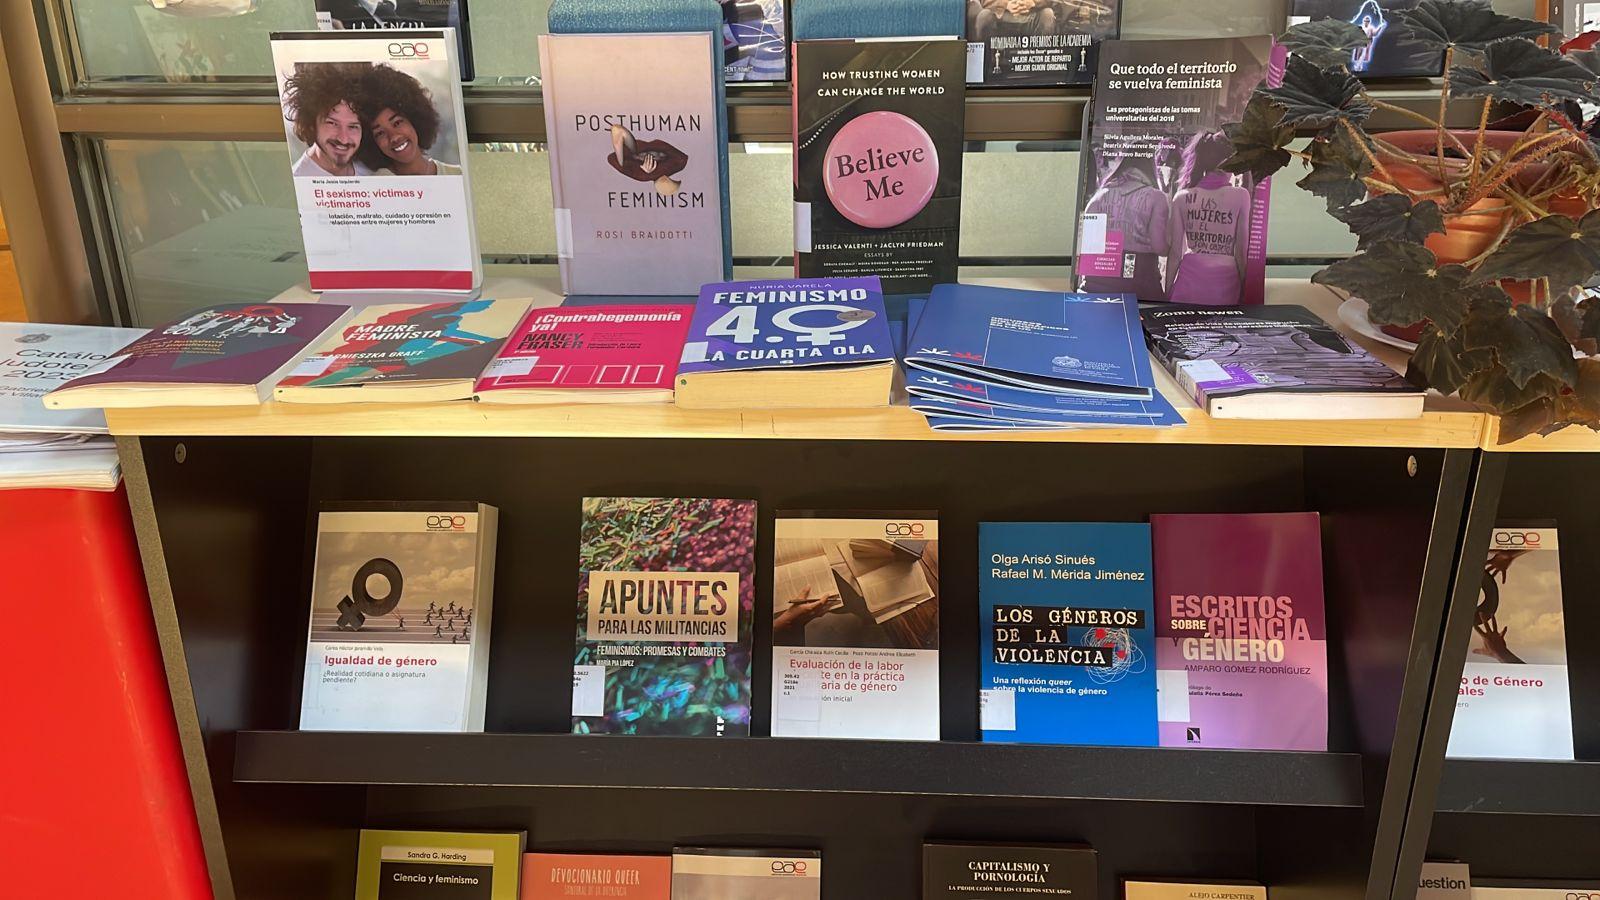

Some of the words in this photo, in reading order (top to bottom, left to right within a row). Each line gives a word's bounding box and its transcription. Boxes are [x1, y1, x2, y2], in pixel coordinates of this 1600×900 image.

[991, 37, 1017, 48] NOMINADA
[1022, 37, 1028, 48] 9
[1030, 35, 1052, 47] PREMIOS
[1053, 35, 1059, 47] DE
[1060, 35, 1066, 47] LA
[1066, 34, 1091, 46] ACADEMIA
[1111, 63, 1134, 75] Que
[1137, 63, 1163, 74] todo
[1167, 63, 1177, 74] el
[1180, 61, 1236, 74] territorio
[822, 72, 846, 80] HOW
[850, 71, 898, 79] TRUSTING
[902, 70, 940, 78] WOMEN
[1109, 80, 1121, 89] se
[1124, 78, 1163, 89] vuelva
[1165, 78, 1222, 89] feminista
[818, 88, 839, 97] CAN
[842, 88, 884, 96] CHANGE
[887, 87, 906, 95] THE
[909, 86, 945, 95] WORLD
[1118, 106, 1161, 114] protagonistas
[576, 114, 701, 131] POSTHUMAN
[834, 146, 925, 178] Believe
[863, 175, 904, 201] Me
[314, 190, 324, 198] El
[327, 190, 370, 198] sexismo:
[373, 189, 414, 198] víctimas
[418, 190, 423, 199] y
[316, 200, 370, 208] victimarios
[608, 192, 704, 208] FEMINISM
[1201, 198, 1217, 209] LAS
[1188, 209, 1233, 224] MUJERES
[596, 231, 623, 239] ROSI
[631, 231, 693, 239] BRAIDOTTI
[713, 288, 867, 304] FEMINISMO
[354, 324, 420, 333] MADRE
[528, 322, 557, 333] ya!
[346, 330, 442, 341] FEMINISTA
[523, 333, 584, 342] NANCY
[517, 341, 584, 350] FRASER
[16, 348, 107, 360] Catálo
[736, 347, 823, 361] CUARTA
[833, 344, 875, 356] OLA
[0, 358, 89, 370] ludote
[991, 554, 1018, 566] Olga
[1022, 554, 1051, 564] Arisó
[1055, 555, 1095, 565] Sinués
[992, 569, 1029, 579] Rafael
[1033, 570, 1047, 579] M.
[1051, 569, 1091, 580] Mérida
[1095, 570, 1144, 581] Jiménez
[599, 580, 727, 615] APUNTES
[1170, 595, 1293, 618] ESCRITOS
[996, 606, 1033, 623] LOS
[1049, 607, 1138, 625] GÉNEROS
[598, 620, 627, 634] PARA
[631, 620, 651, 634] LAS
[655, 621, 726, 635] MILITANCIAS
[1171, 620, 1206, 630] SOBRE
[1208, 617, 1311, 640] CIENCIA
[996, 629, 1020, 642] DE
[1036, 629, 1061, 644] LA
[597, 646, 642, 655] FEMINISMOS:
[643, 646, 681, 656] PROMESAS
[682, 647, 687, 656] Y
[688, 647, 726, 657] COMBATES
[1172, 638, 1179, 647] Y
[1183, 632, 1284, 662] GÉNERO
[996, 647, 1105, 664] VIOLENCIA
[325, 656, 374, 666] Igualdad
[378, 656, 391, 665] de
[396, 656, 437, 667] género
[790, 659, 845, 669] Evaluación
[849, 660, 861, 669] de
[865, 661, 873, 670] la
[878, 662, 904, 670] labor
[1185, 665, 1222, 673] AMPARO
[1259, 665, 1311, 675] RODRÍGUEZ
[835, 672, 847, 680] en
[851, 671, 859, 680] la
[863, 671, 904, 682] práctica
[1011, 677, 1046, 685] reflexión
[1473, 676, 1488, 685] de
[1494, 676, 1543, 687] Género
[844, 681, 857, 690] de
[861, 683, 897, 692] género
[1028, 686, 1064, 694] violencia
[1078, 687, 1107, 696] género
[408, 851, 431, 859] Sandra
[442, 852, 467, 861] Harding
[968, 861, 1040, 872] CAPITALISMO
[1043, 864, 1050, 872] Y
[393, 873, 427, 883] Ciencia
[428, 876, 433, 884] y
[435, 875, 479, 885] feminismo
[551, 868, 611, 885] DEVOCIONARIO
[615, 870, 640, 886] QUEER
[974, 872, 1045, 883] PORNOLOGÍA
[1418, 878, 1466, 889] uestion
